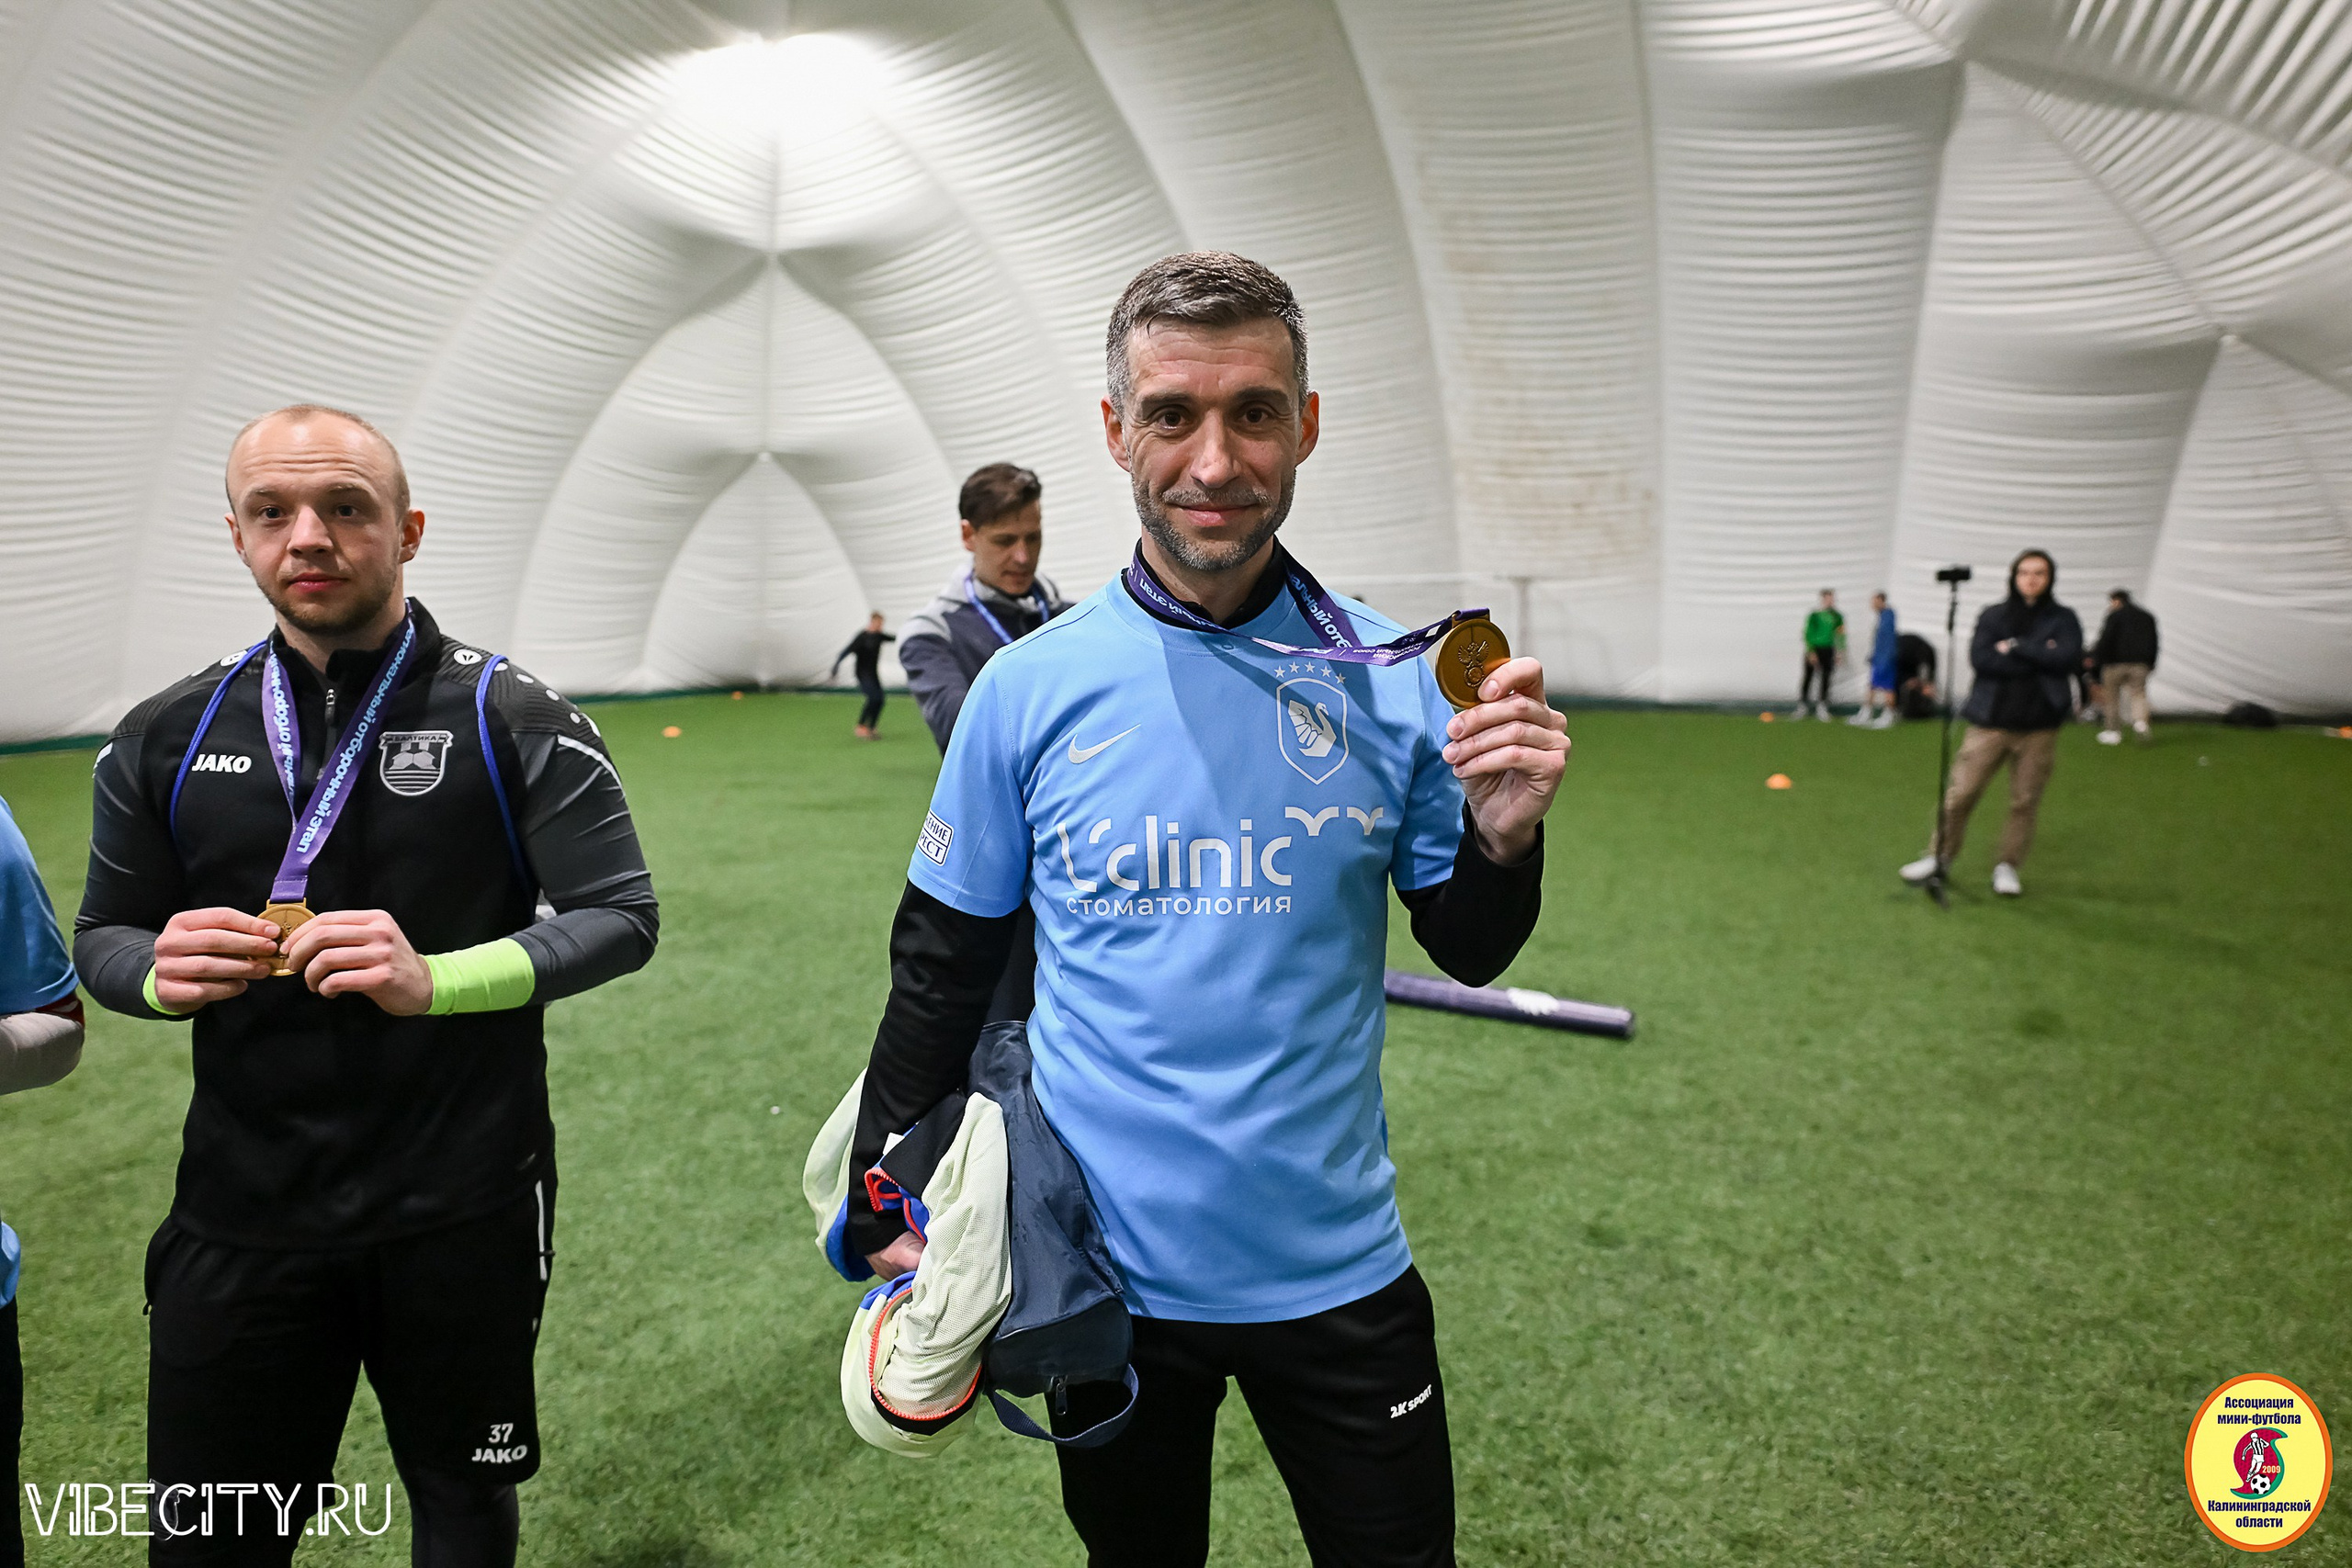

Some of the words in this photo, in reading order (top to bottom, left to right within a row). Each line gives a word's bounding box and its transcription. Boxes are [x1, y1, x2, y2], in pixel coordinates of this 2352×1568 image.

[1324, 623, 1352, 648] отб
[192, 754, 252, 773] JAKO
[315, 721, 368, 817] отборочный
[297, 815, 323, 852] этап
[926, 817, 949, 841] ЕНИЕ
[1066, 895, 1292, 917] стоматология
[1390, 1401, 1408, 1419] 2K
[1408, 1383, 1431, 1411] SPORT
[488, 1423, 514, 1443] 37
[471, 1445, 527, 1463] JAKO
